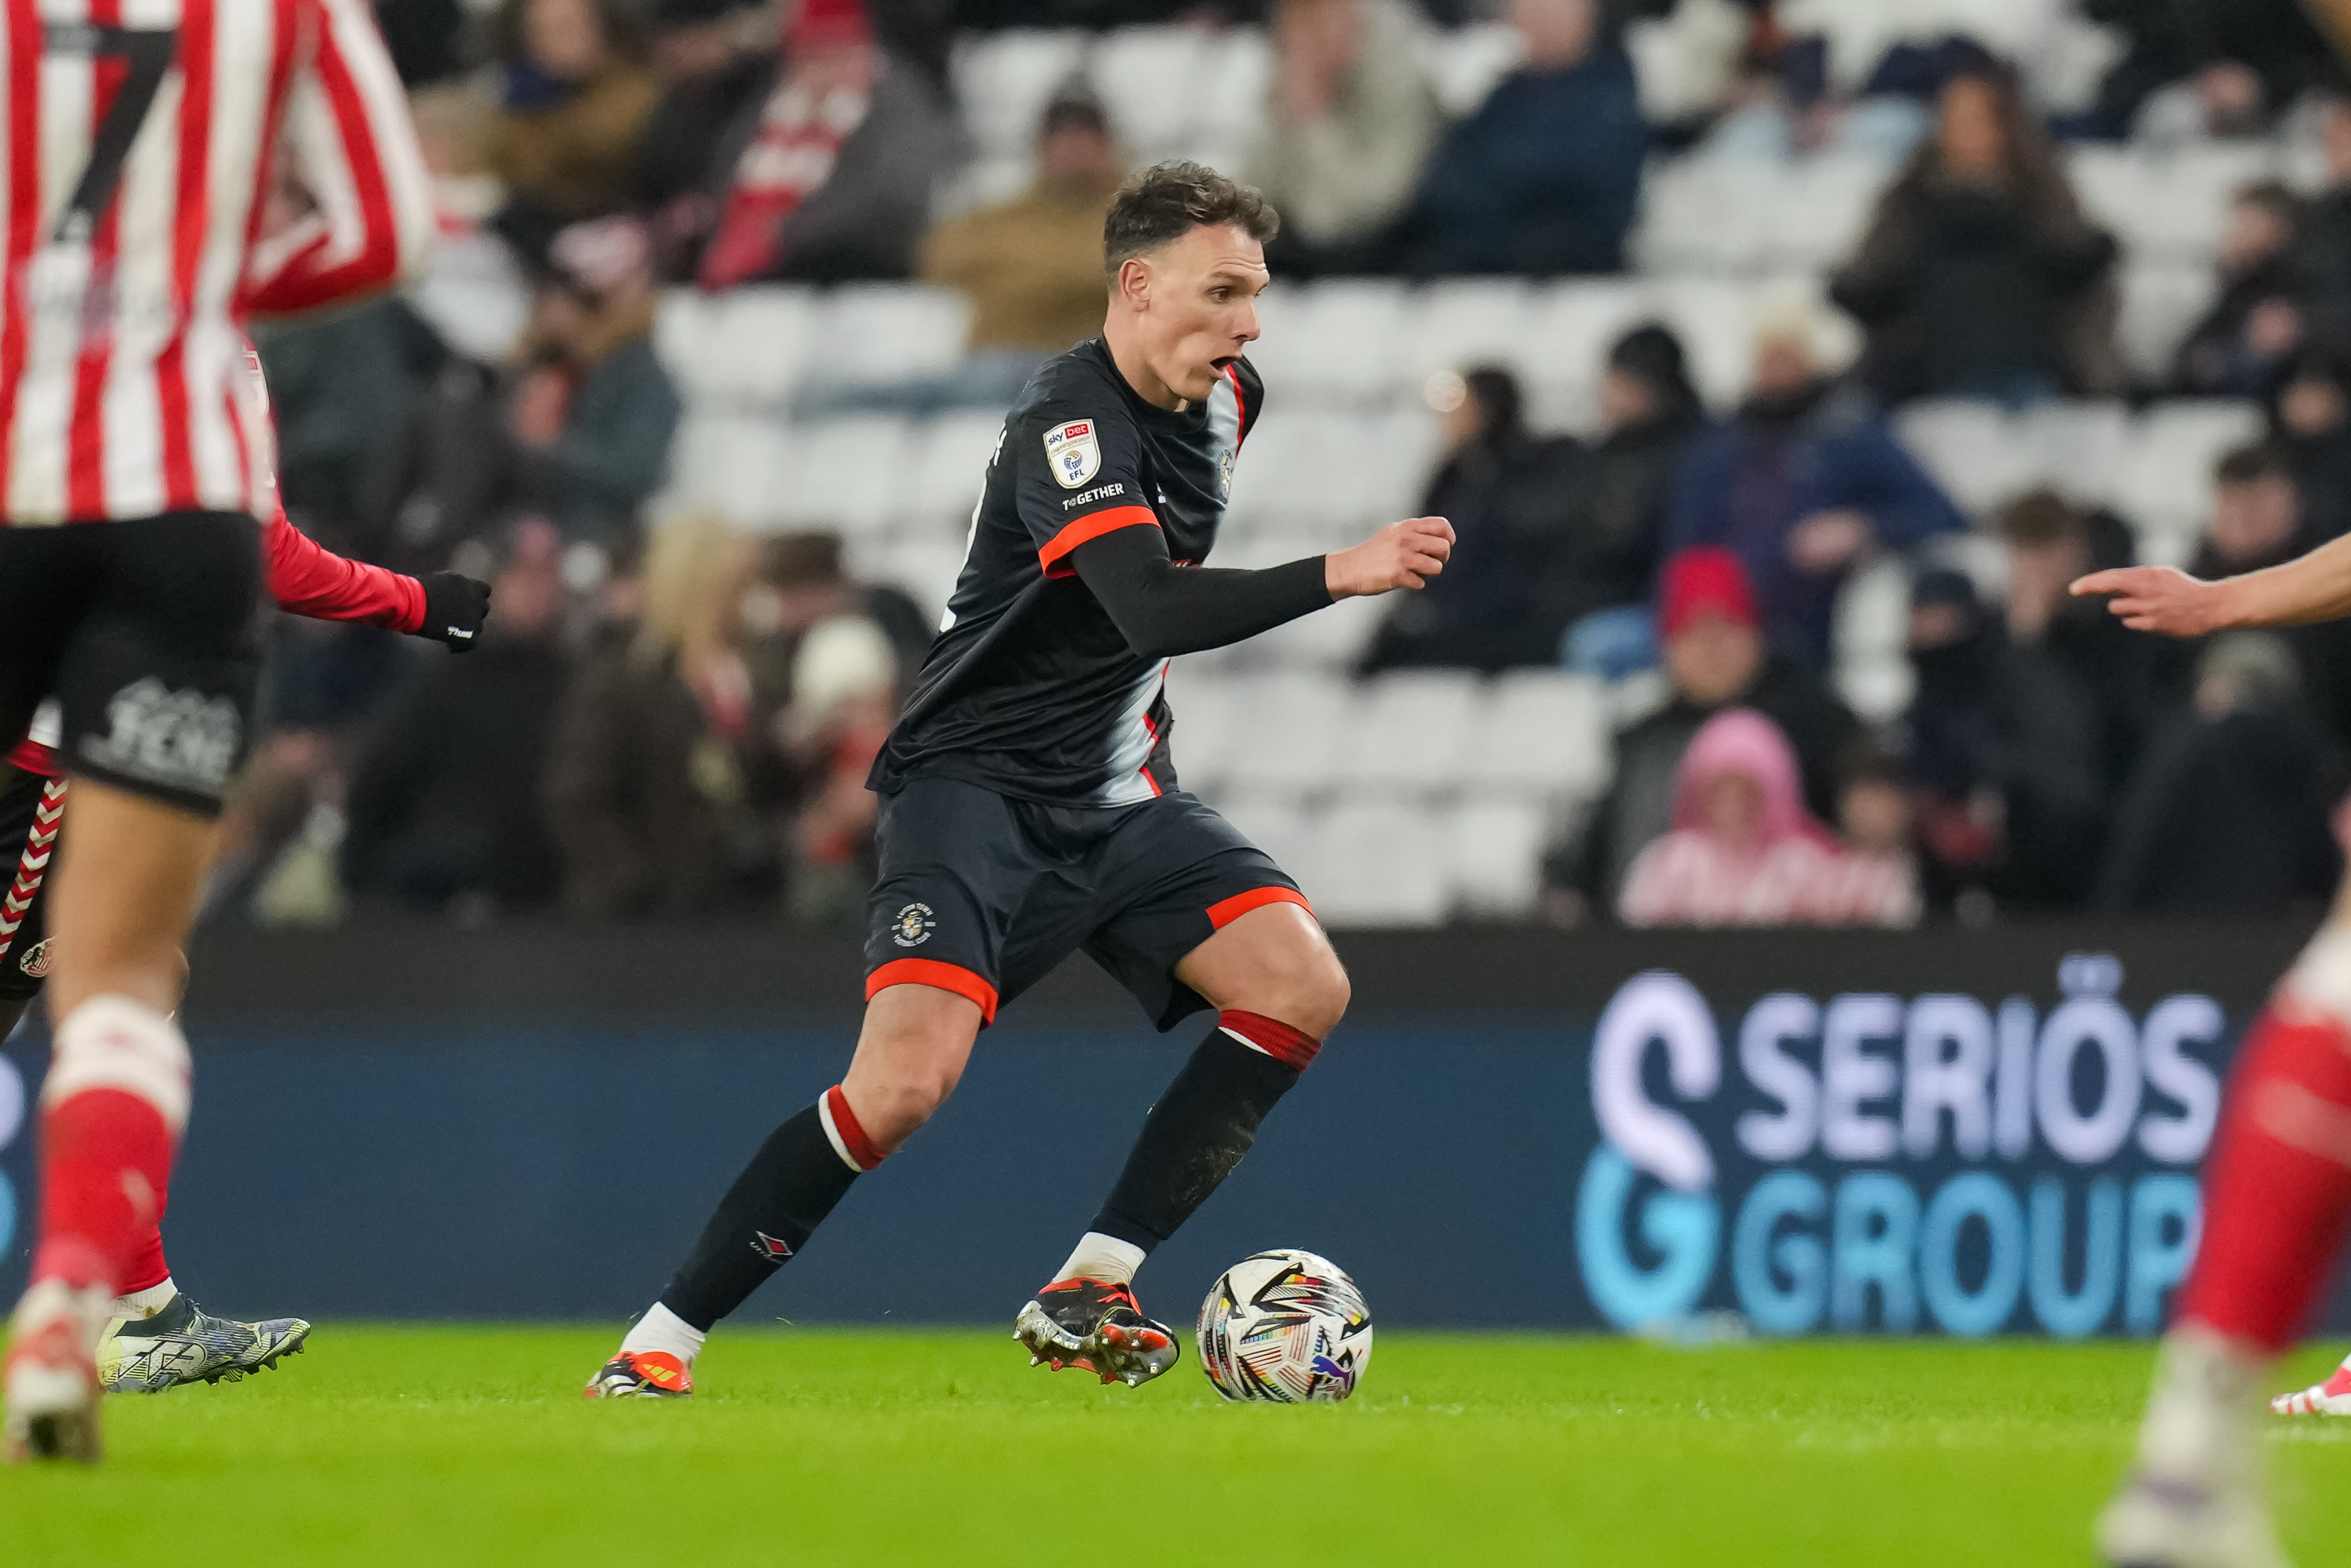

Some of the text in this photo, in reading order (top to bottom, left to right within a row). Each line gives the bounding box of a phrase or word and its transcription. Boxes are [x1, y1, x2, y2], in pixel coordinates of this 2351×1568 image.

[44, 25, 177, 244] 7
[1048, 425, 1088, 446] sky bet
[1051, 436, 1091, 455] CHAMPIONSHIP
[1070, 469, 1085, 480] EFL
[1733, 951, 2227, 1164] SERIÖS
[1732, 1169, 2205, 1338] GROUP
